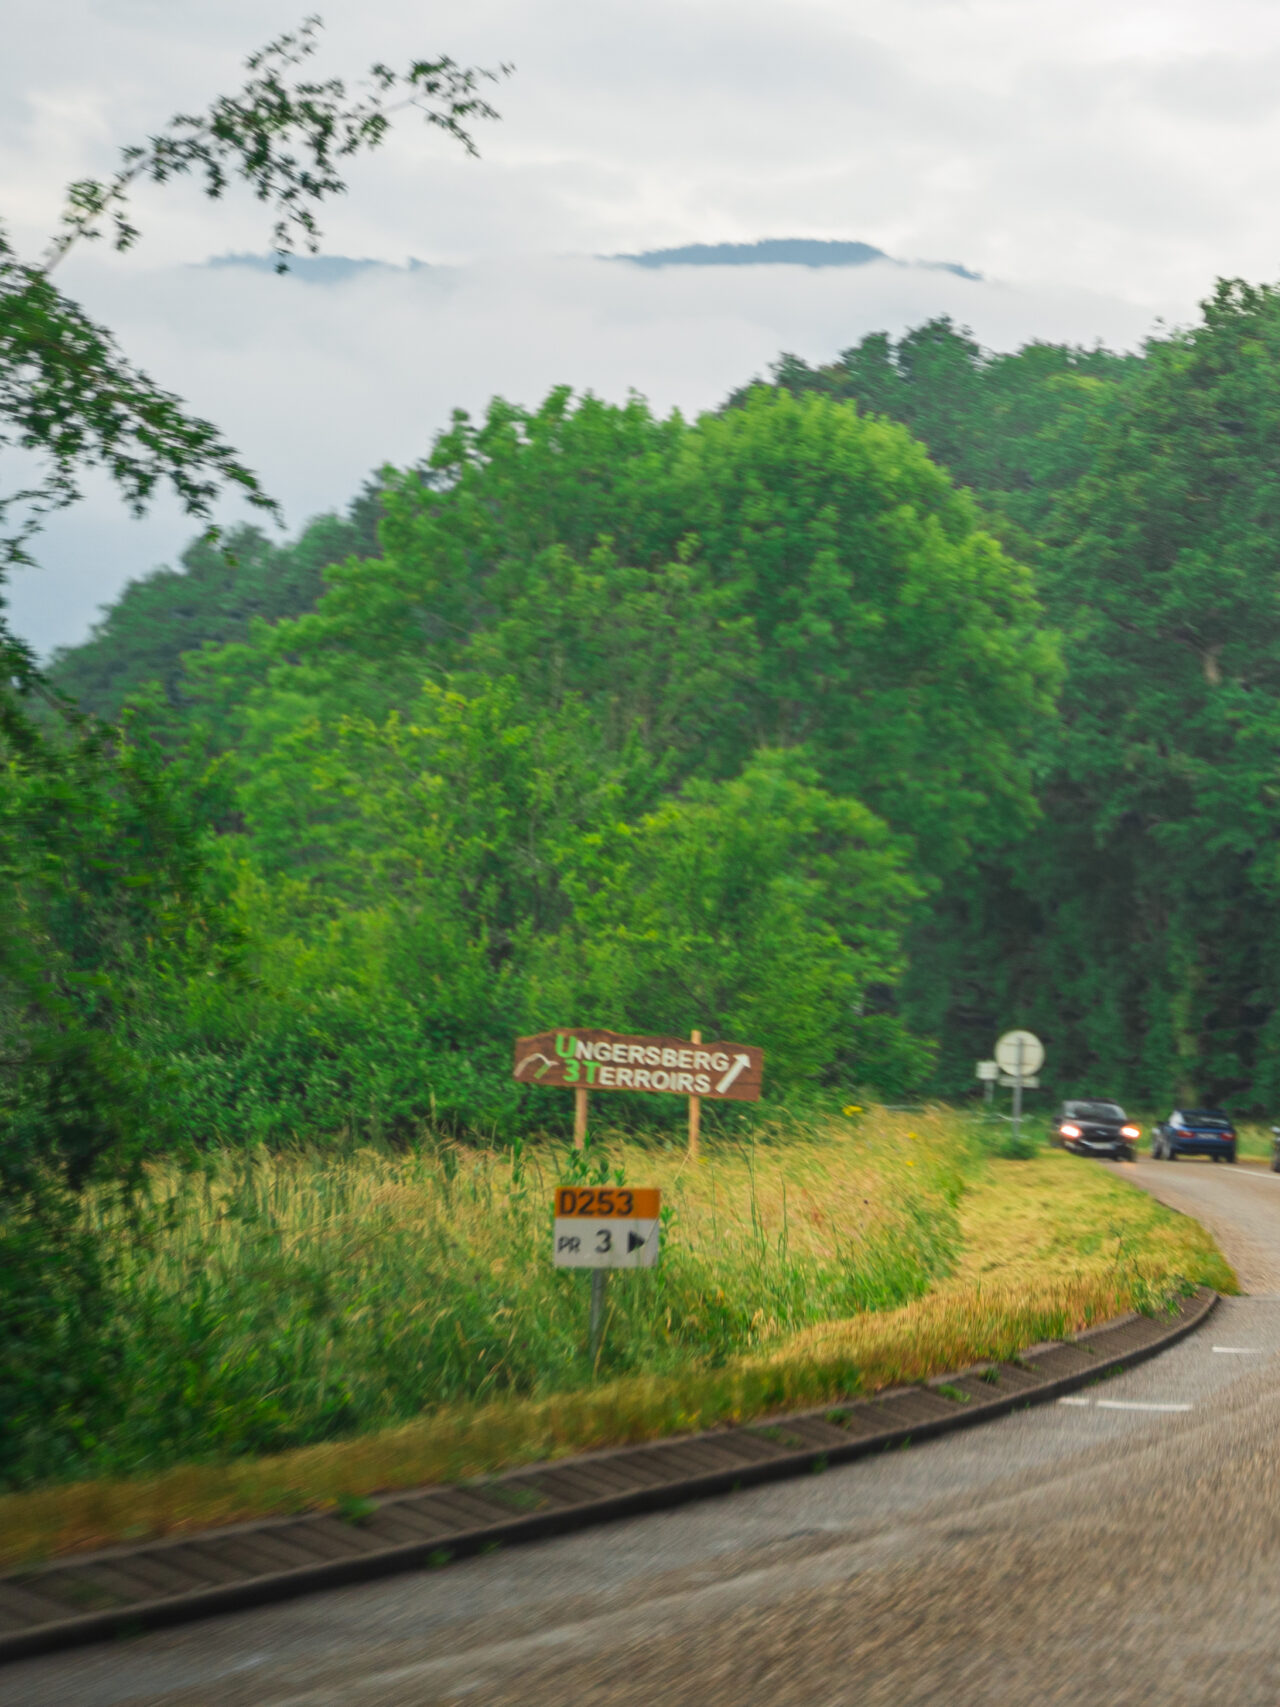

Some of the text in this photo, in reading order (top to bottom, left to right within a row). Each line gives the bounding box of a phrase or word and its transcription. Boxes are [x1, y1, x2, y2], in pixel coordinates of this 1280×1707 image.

[554, 1034, 730, 1072] UNGERSBERG
[562, 1059, 712, 1094] 3 TERROIRS
[559, 1190, 634, 1216] D253
[557, 1229, 612, 1254] PR 3
